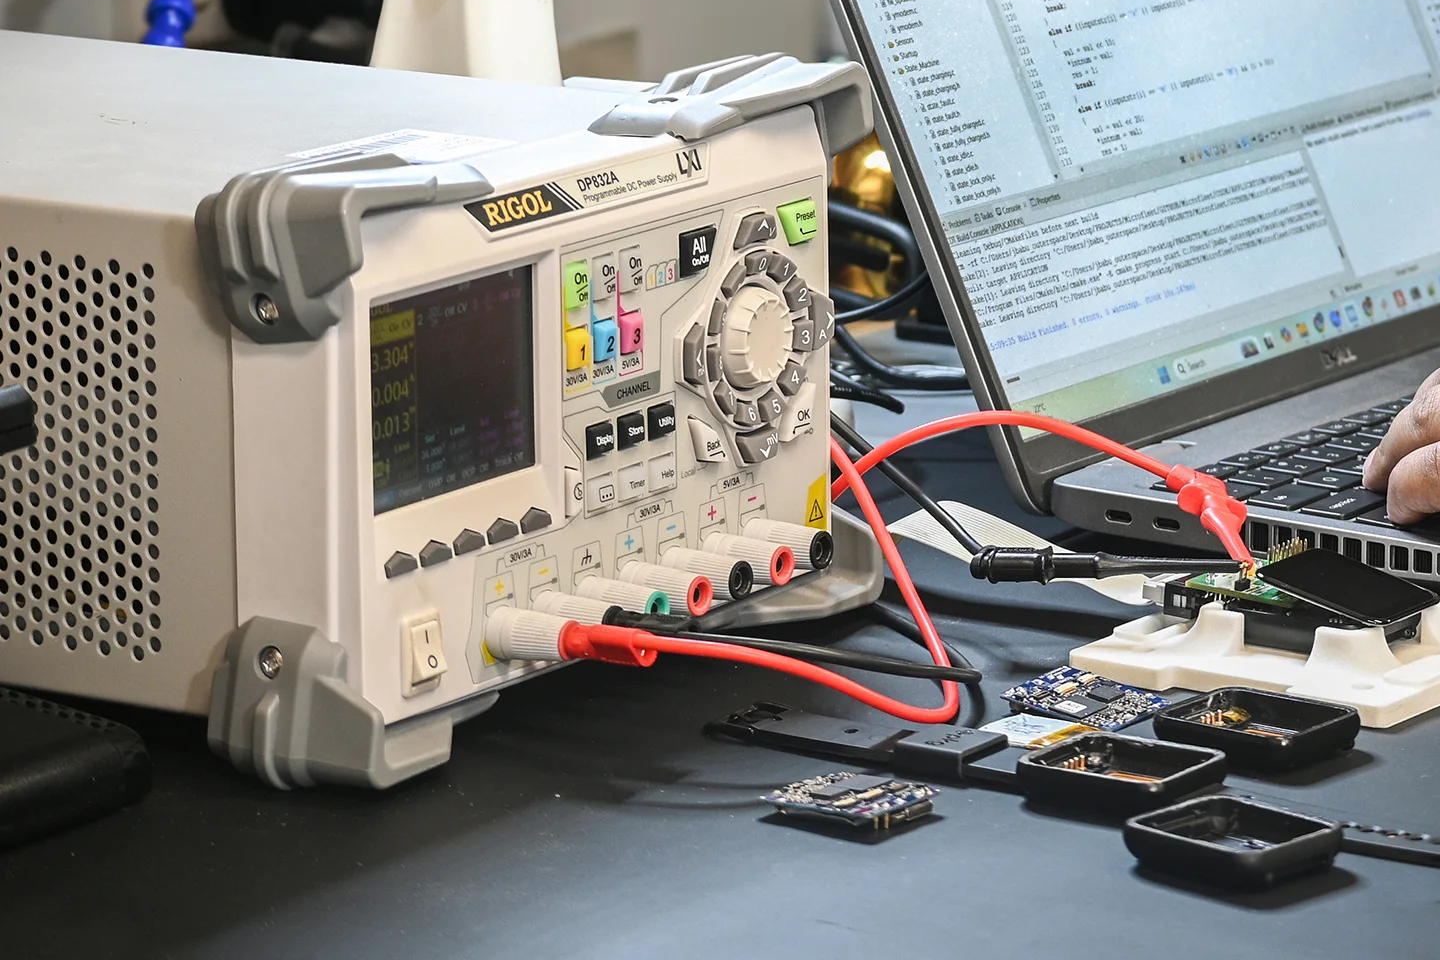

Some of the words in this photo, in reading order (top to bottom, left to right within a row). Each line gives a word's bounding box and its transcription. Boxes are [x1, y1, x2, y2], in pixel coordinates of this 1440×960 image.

[891, 7, 918, 21] ymodem.c
[1044, 2, 1067, 13] break;
[896, 19, 924, 34] ymodem.h
[1047, 27, 1063, 37] else
[1064, 23, 1073, 33] if
[893, 36, 915, 47] Sensors
[898, 49, 919, 60] Startup
[1062, 47, 1075, 57] val
[1081, 42, 1094, 52] val
[903, 58, 941, 73] State_Machine
[916, 69, 956, 85] state_charging.c
[1071, 71, 1083, 79] res
[921, 81, 961, 98] state_charging.h
[1074, 79, 1096, 90] break;
[926, 97, 956, 111] state_fault.c
[1077, 105, 1092, 114] else
[1093, 100, 1102, 110] if
[930, 110, 962, 124] state_fault.h
[935, 118, 986, 137] state_fully_charged.c
[1091, 124, 1104, 134] val
[1111, 119, 1123, 129] val
[941, 131, 991, 150] state_fully_charged.h
[945, 150, 974, 164] state_idle.c
[1100, 147, 1113, 157] res
[675, 148, 703, 179] LXI
[950, 162, 980, 177] state_idle.h
[576, 170, 620, 193] DP832A
[955, 173, 996, 190] state_lock_only.c
[482, 190, 553, 227] RIGOL
[582, 185, 627, 204] Programmable
[627, 181, 637, 194] DC
[637, 177, 657, 191] Power
[656, 171, 678, 188] Supply
[960, 185, 1002, 203] state_lock_only.h
[796, 209, 816, 223] Preset
[947, 217, 973, 229] Problems
[1001, 203, 1022, 215] Console
[1035, 193, 1061, 205] Properties
[1039, 223, 1063, 235] before
[1063, 218, 1079, 228] next
[1079, 211, 1100, 224] build
[955, 231, 970, 243] Build
[968, 227, 990, 239] Console
[692, 235, 707, 256] All
[629, 256, 642, 270] On
[691, 254, 710, 267] On/Off
[758, 257, 767, 271] 0
[990, 260, 1018, 274] Leaving
[1018, 251, 1051, 266] directory
[602, 264, 615, 278] On
[658, 271, 664, 283] 2
[667, 267, 674, 280] 3
[783, 262, 790, 276] 1
[984, 276, 1008, 289] target
[1008, 263, 1049, 282] APPLICATION
[574, 272, 588, 286] On
[633, 275, 643, 286] Off
[999, 283, 1027, 297] Leaving
[1027, 273, 1060, 289] directory
[578, 290, 589, 302] Off
[606, 283, 616, 294] Off
[798, 287, 807, 302] 2
[997, 309, 1025, 323] Leaving
[1025, 299, 1059, 315] directory
[801, 329, 811, 345] 3
[819, 328, 827, 340] A
[1016, 330, 1037, 343] Build
[580, 344, 586, 361] 1
[606, 336, 615, 353] 2
[633, 327, 641, 345] 3
[621, 357, 640, 370] 5V/3A
[1186, 358, 1207, 371] Search
[592, 365, 615, 379] 30V/3A
[791, 369, 800, 385] 4
[565, 373, 588, 388] 30V/3A
[373, 380, 410, 408] 0.004
[616, 381, 652, 401] CHANNEL
[771, 398, 781, 414] 5
[749, 406, 757, 422] 6
[797, 409, 811, 422] OK
[373, 412, 411, 440] 0.013
[596, 433, 614, 447] Display
[628, 424, 645, 437] Store
[658, 414, 675, 428] Utility
[706, 438, 721, 452] Back
[766, 432, 779, 447] mV
[629, 479, 646, 490] Timer
[661, 468, 675, 480] Help
[680, 467, 697, 480] Local
[722, 476, 741, 490] 5V/3A
[639, 502, 661, 519] 30V/3A
[508, 546, 533, 564] 30V/3A
